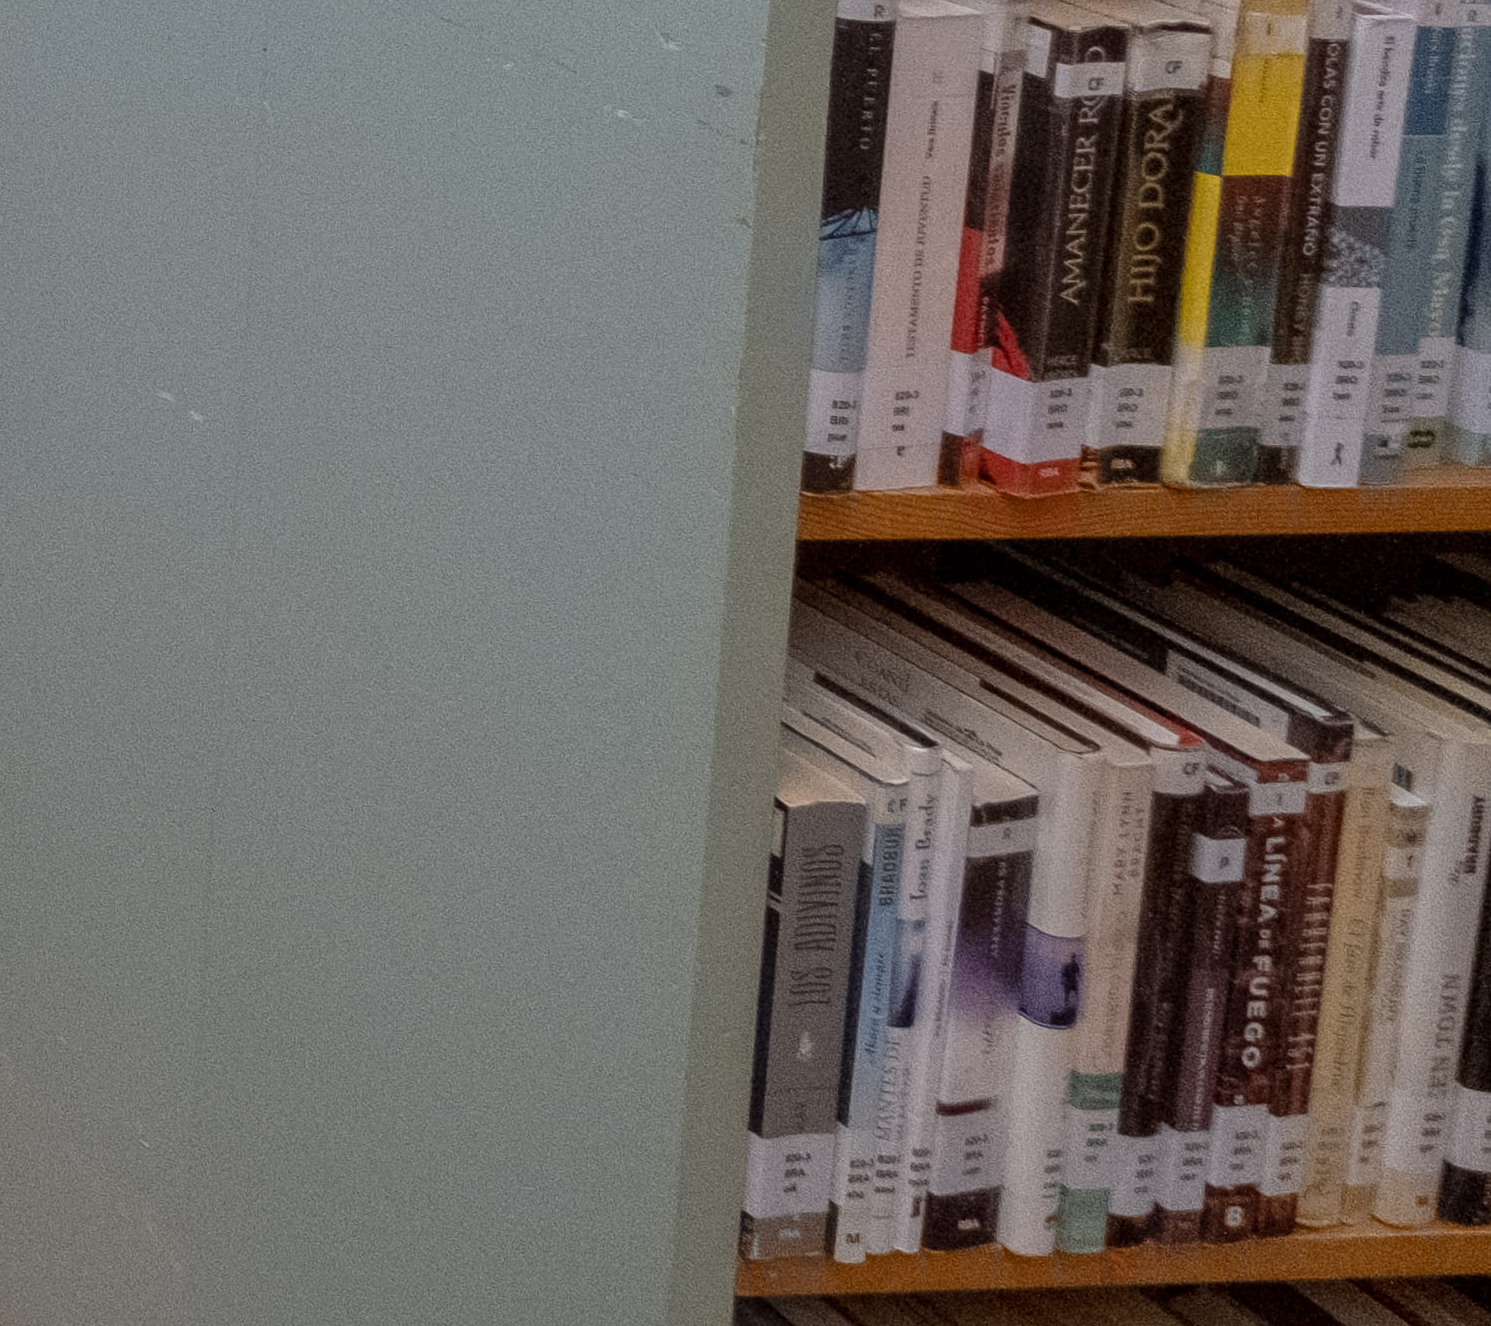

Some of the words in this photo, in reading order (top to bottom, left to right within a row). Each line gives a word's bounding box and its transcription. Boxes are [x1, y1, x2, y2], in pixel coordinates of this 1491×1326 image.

[1059, 135, 1099, 306] AMANECER
[1126, 220, 1163, 306] HIJO
[1257, 835, 1287, 924] LÍNEA
[1241, 954, 1272, 1069] FUEGO
